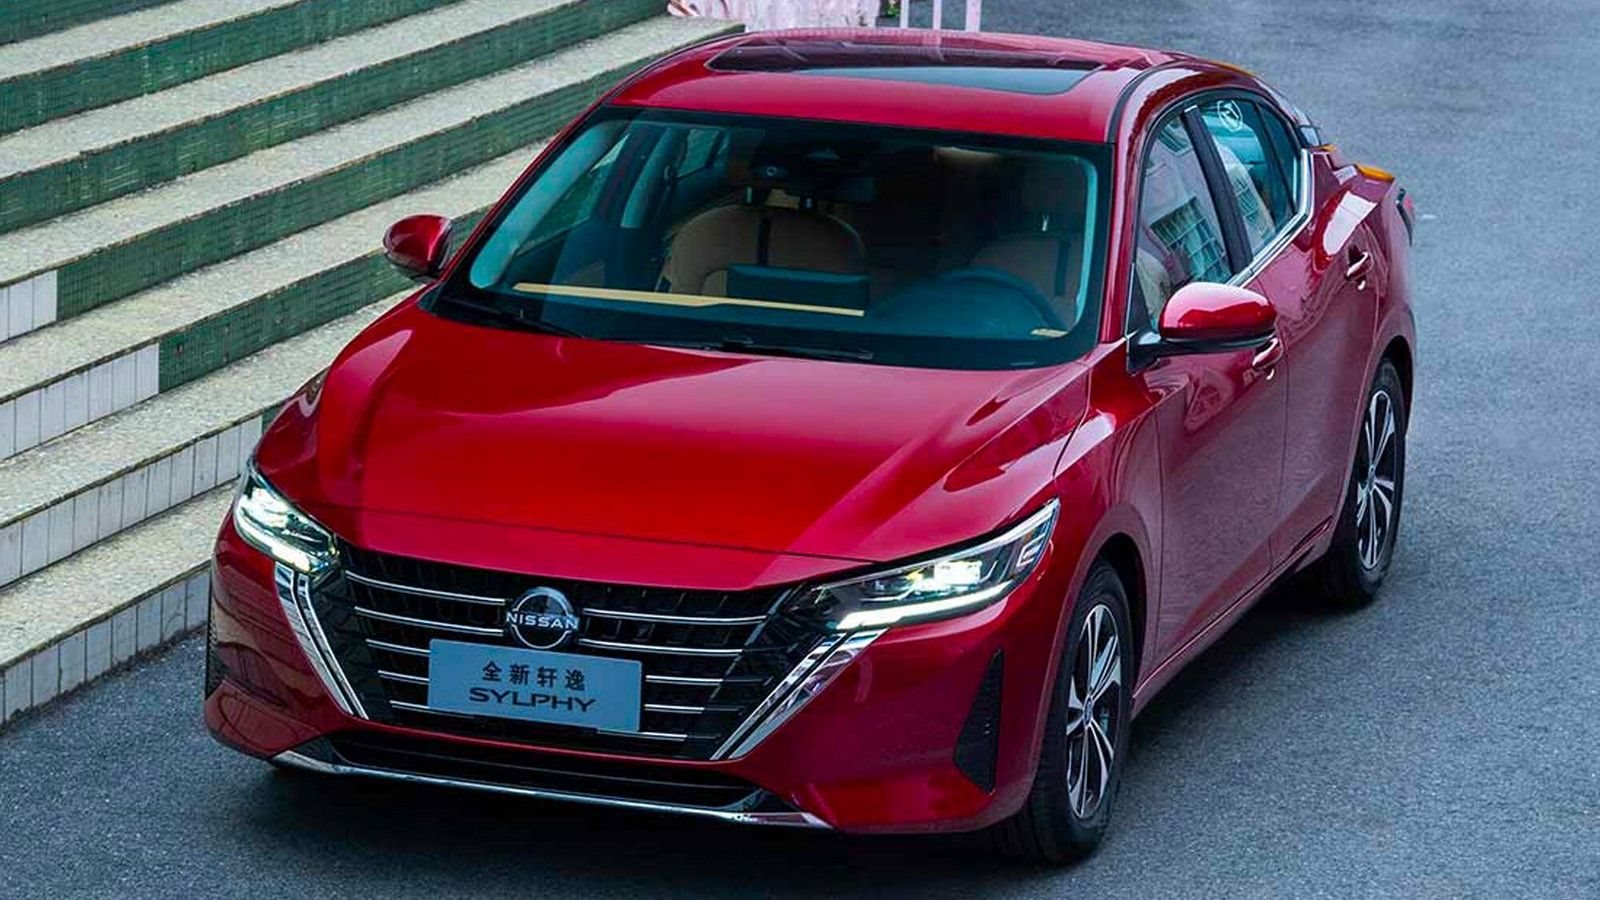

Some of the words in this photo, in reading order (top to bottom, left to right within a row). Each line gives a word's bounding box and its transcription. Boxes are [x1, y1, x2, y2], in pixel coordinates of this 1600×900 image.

[505, 611, 580, 630] NISSAN
[482, 660, 585, 691] 全新轩逸
[468, 687, 596, 712] SYLPHY
